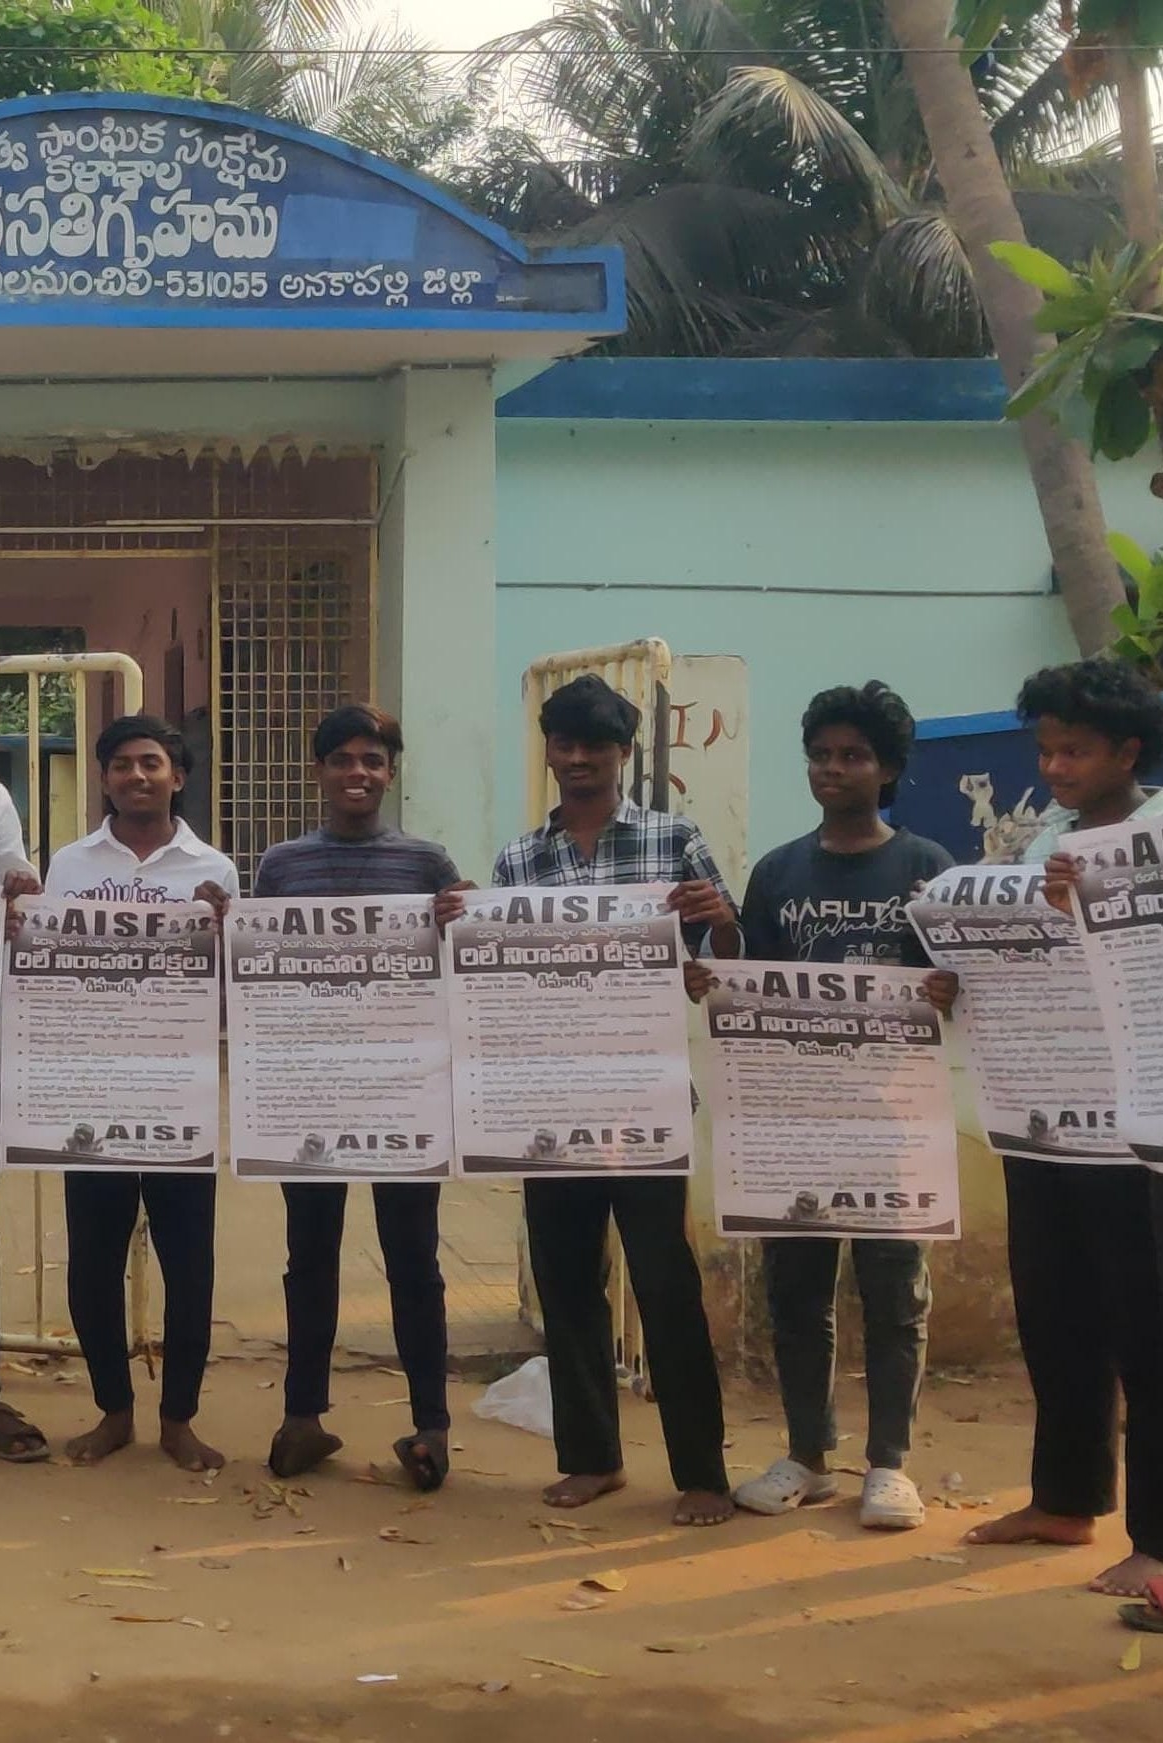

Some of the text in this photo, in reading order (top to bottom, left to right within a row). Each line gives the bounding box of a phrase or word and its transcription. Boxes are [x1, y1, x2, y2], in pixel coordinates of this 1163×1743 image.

[36, 117, 168, 159] సాంఘిక
[175, 128, 286, 190] సంక్షేమ
[45, 154, 182, 200] కళాశాల
[279, 264, 409, 307] అనకాపల్లి
[422, 268, 481, 305] జిల్లా
[61, 908, 166, 937] AISF
[283, 906, 384, 935] AISF
[506, 896, 619, 924] AISF
[762, 971, 876, 1002] AISF
[105, 1125, 200, 1140] AISF
[1058, 1110, 1116, 1128] AIS
[336, 1134, 435, 1150] AISF
[568, 1127, 673, 1145] AISF
[830, 1192, 937, 1209] AISF
